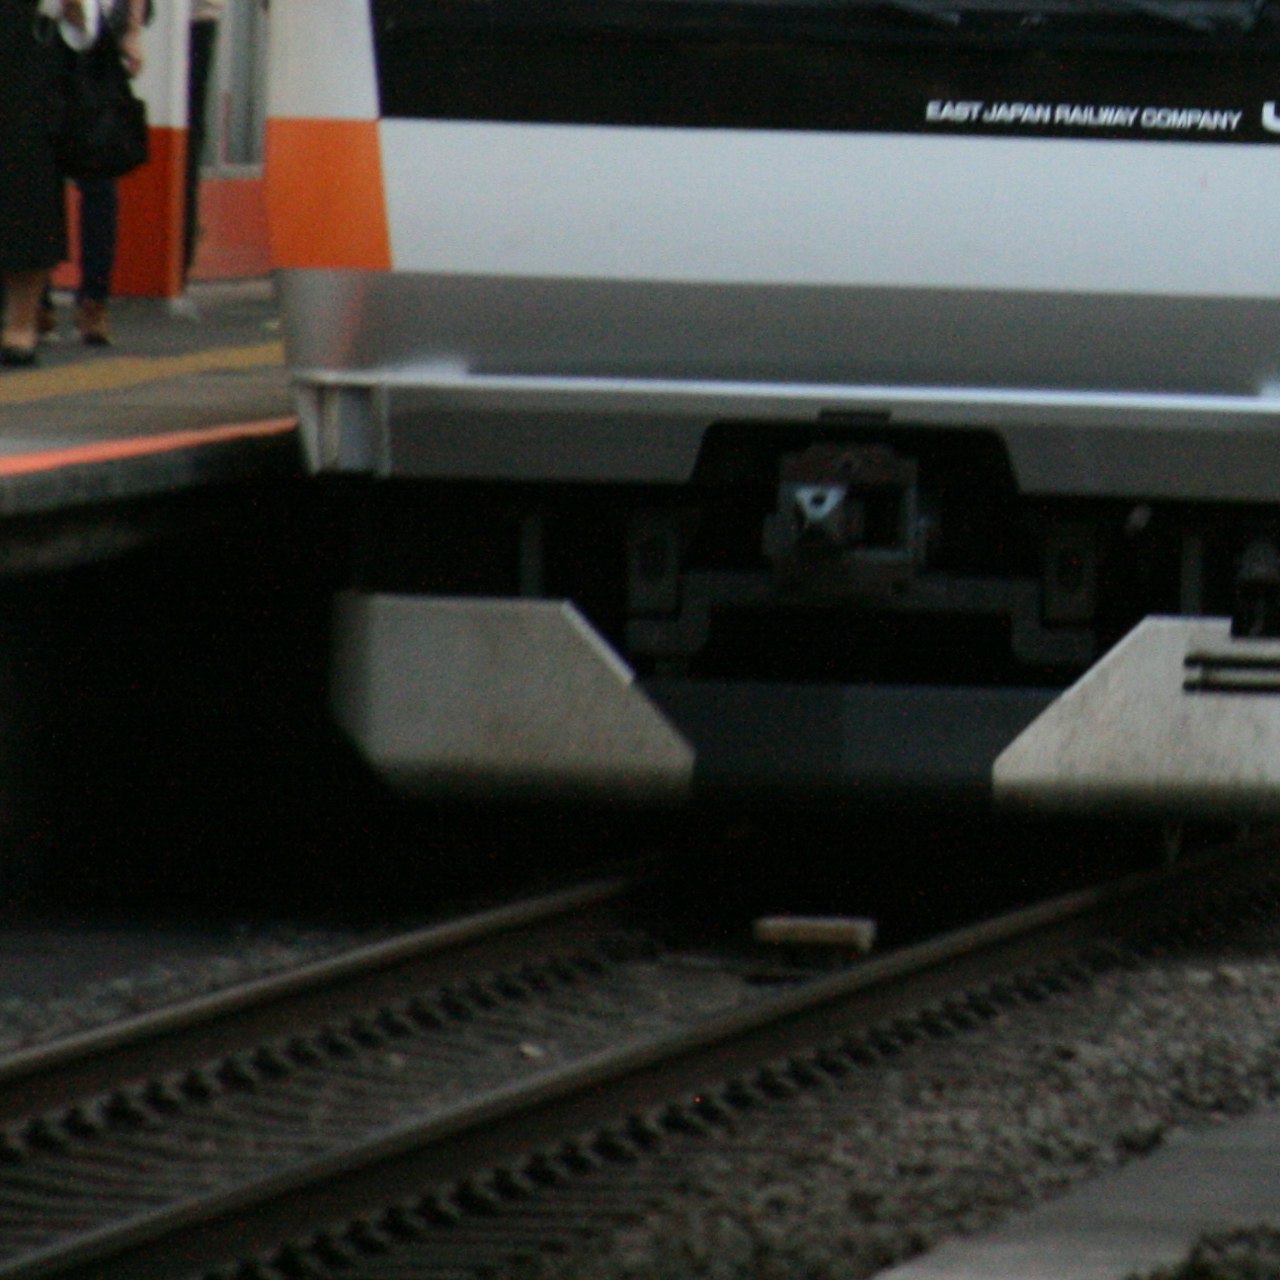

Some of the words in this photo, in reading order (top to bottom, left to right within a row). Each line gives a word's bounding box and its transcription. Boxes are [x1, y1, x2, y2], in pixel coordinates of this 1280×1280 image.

[925, 100, 984, 121] EAST
[983, 102, 1051, 125] JAPAN
[1055, 104, 1141, 129] RAILWAY
[1140, 107, 1243, 131] COMPANY
